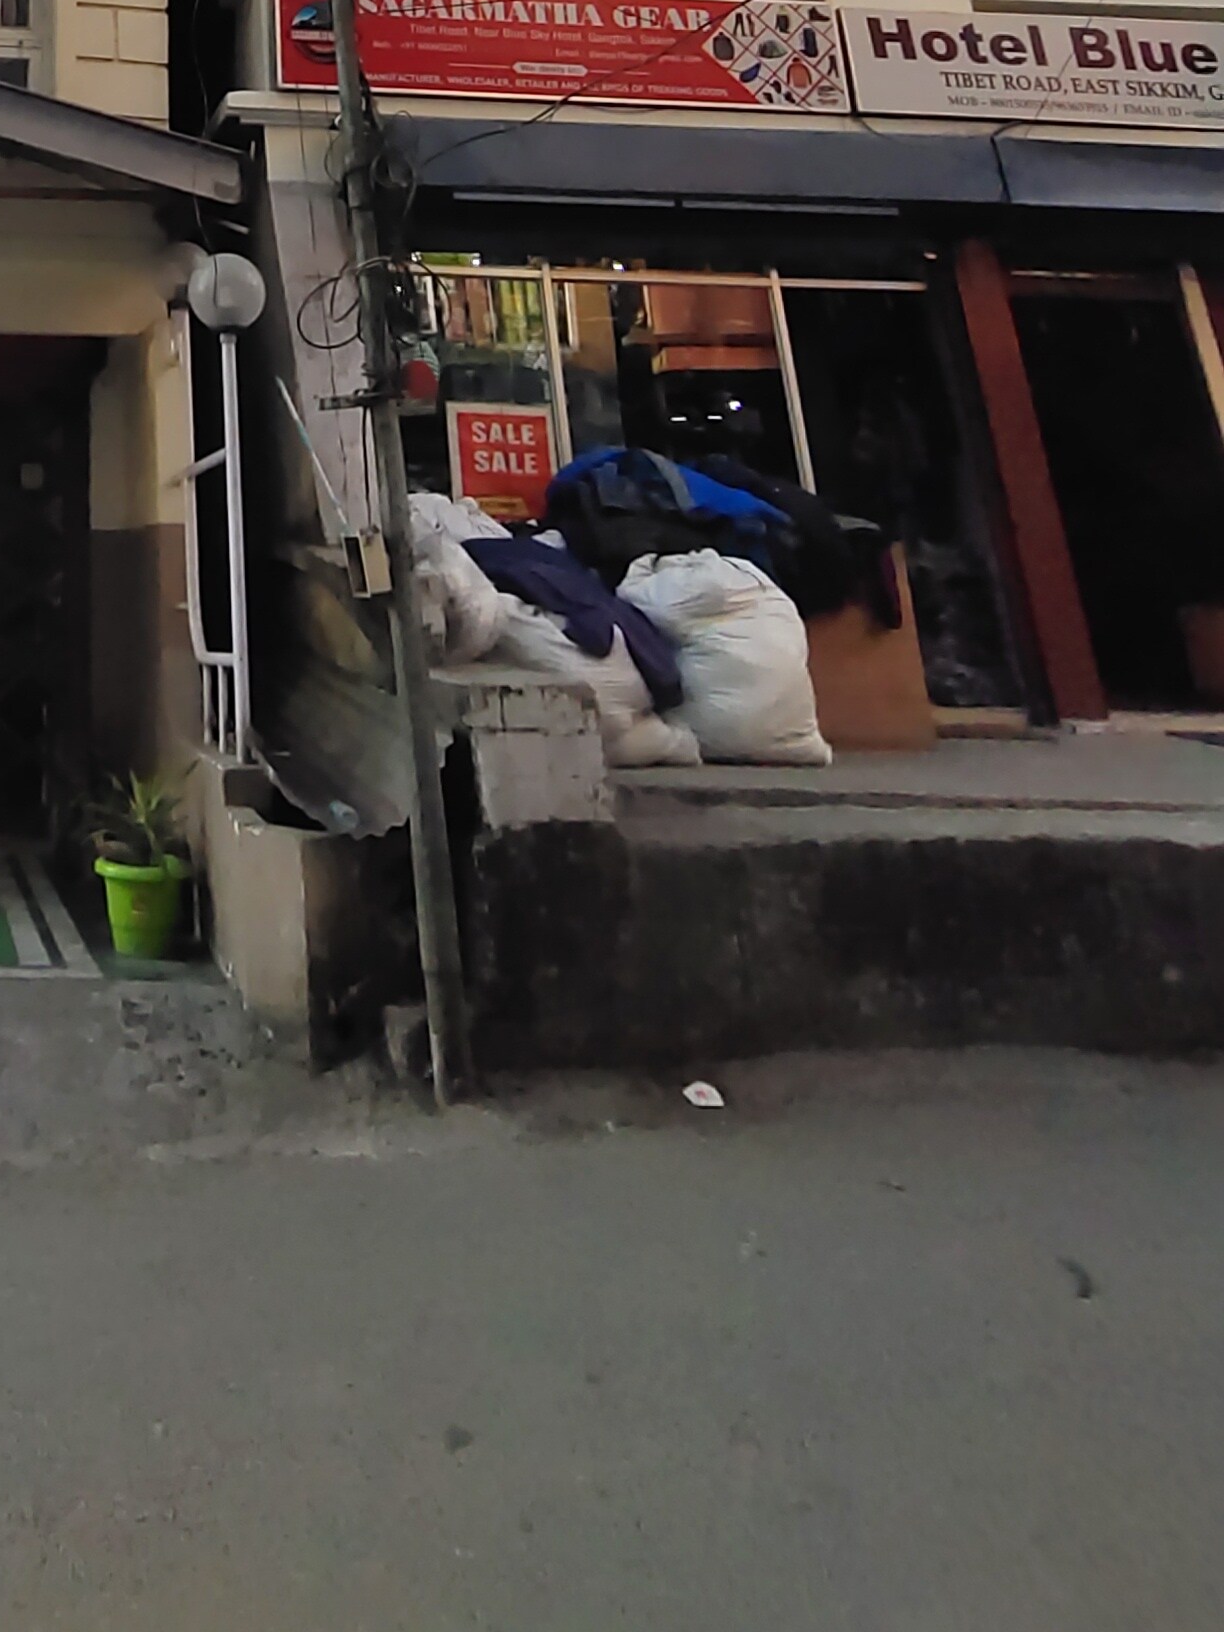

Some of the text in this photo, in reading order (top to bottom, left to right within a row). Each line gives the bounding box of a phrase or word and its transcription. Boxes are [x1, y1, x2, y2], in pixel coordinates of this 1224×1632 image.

[612, 4, 713, 33] GEAR
[866, 16, 1219, 75] Hotel Blue
[561, 81, 581, 91] AND
[940, 71, 996, 89] TIBET
[1002, 74, 1068, 95] ROAD,
[1070, 77, 1120, 96] EAST
[1126, 79, 1205, 101] SIKKIM,
[471, 421, 536, 446] SALE
[473, 450, 539, 475] SALE
